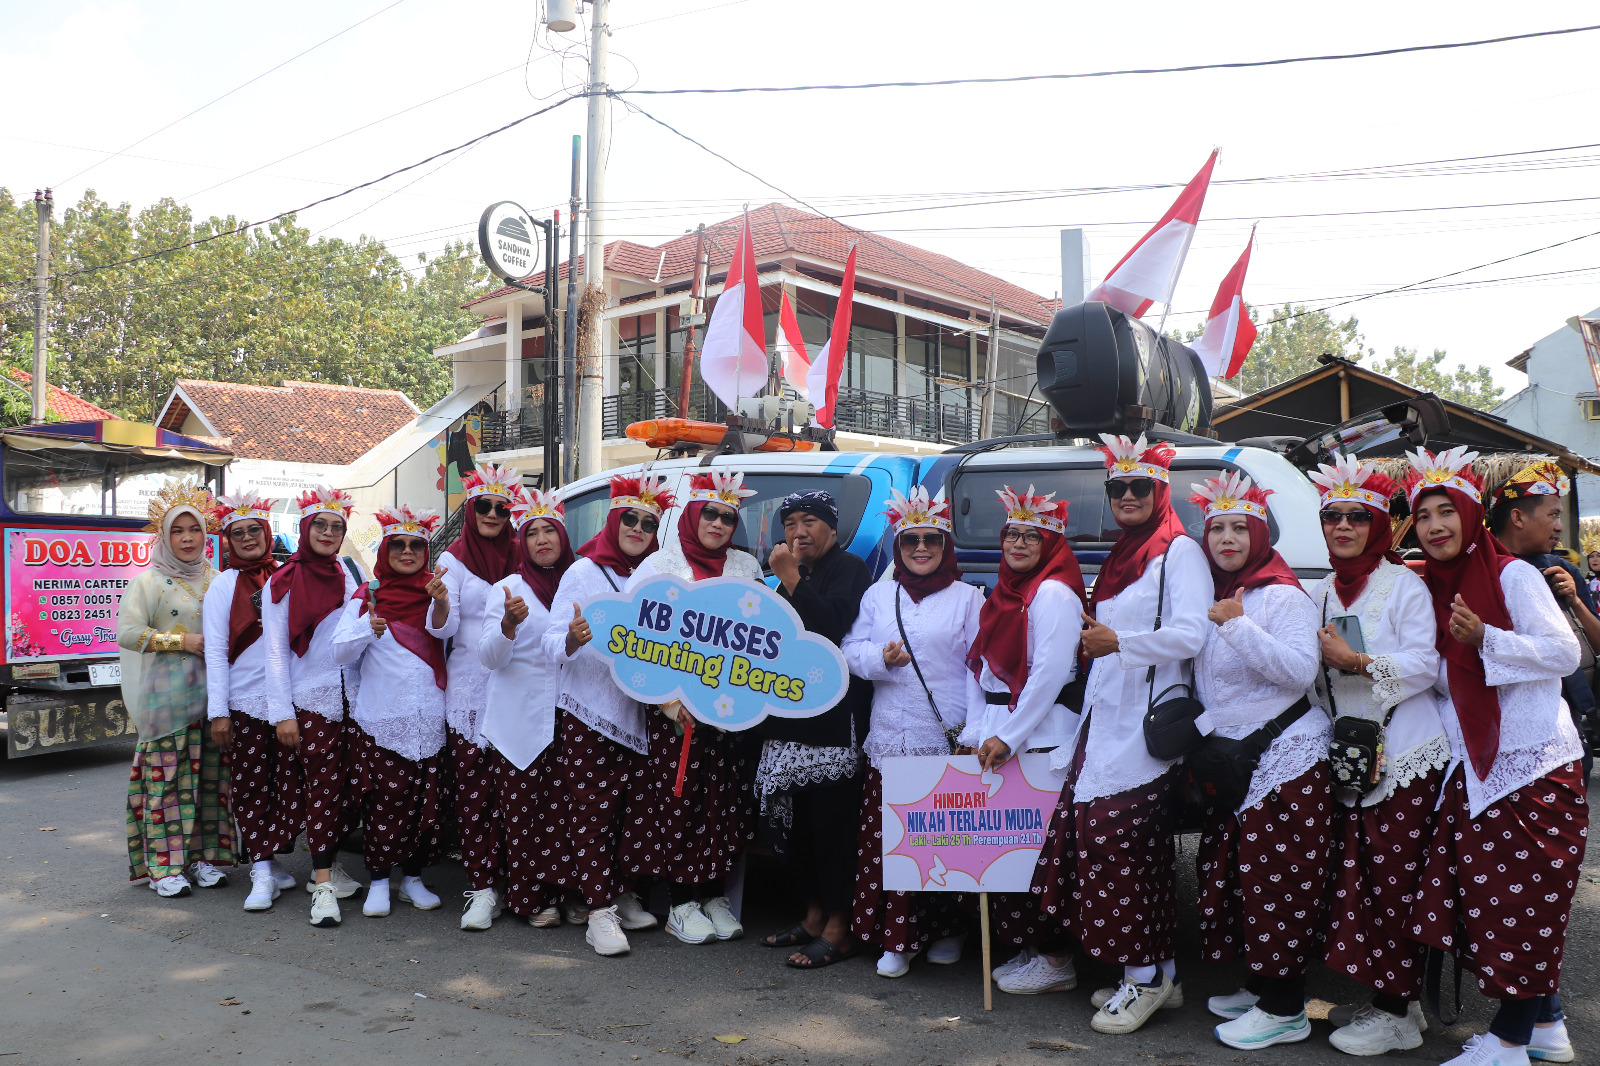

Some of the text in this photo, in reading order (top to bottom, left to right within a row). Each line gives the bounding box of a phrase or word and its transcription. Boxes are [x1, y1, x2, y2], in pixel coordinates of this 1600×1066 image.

[498, 239, 531, 258] SANDHYA
[502, 253, 527, 268] COFFEE
[24, 538, 152, 566] DOA IBU
[34, 579, 81, 590] NERIMA
[51, 595, 80, 605] 0857
[84, 594, 112, 604] 0005
[51, 610, 81, 620] 0823
[84, 609, 111, 619] 2451
[60, 628, 92, 646] Gessy
[637, 598, 782, 660] KB SUKSES
[607, 624, 805, 701] Stunting Beres
[91, 666, 98, 678] B
[933, 791, 986, 809] HINDARI
[907, 808, 1044, 833] NIKAH TERLALU MUDA
[909, 835, 927, 846] Laki
[931, 835, 949, 846] Laki
[950, 834, 961, 845] 25
[961, 834, 972, 846] Th
[972, 833, 1019, 847] Perempuan
[1020, 833, 1031, 844] 21
[1031, 832, 1042, 844] Th
